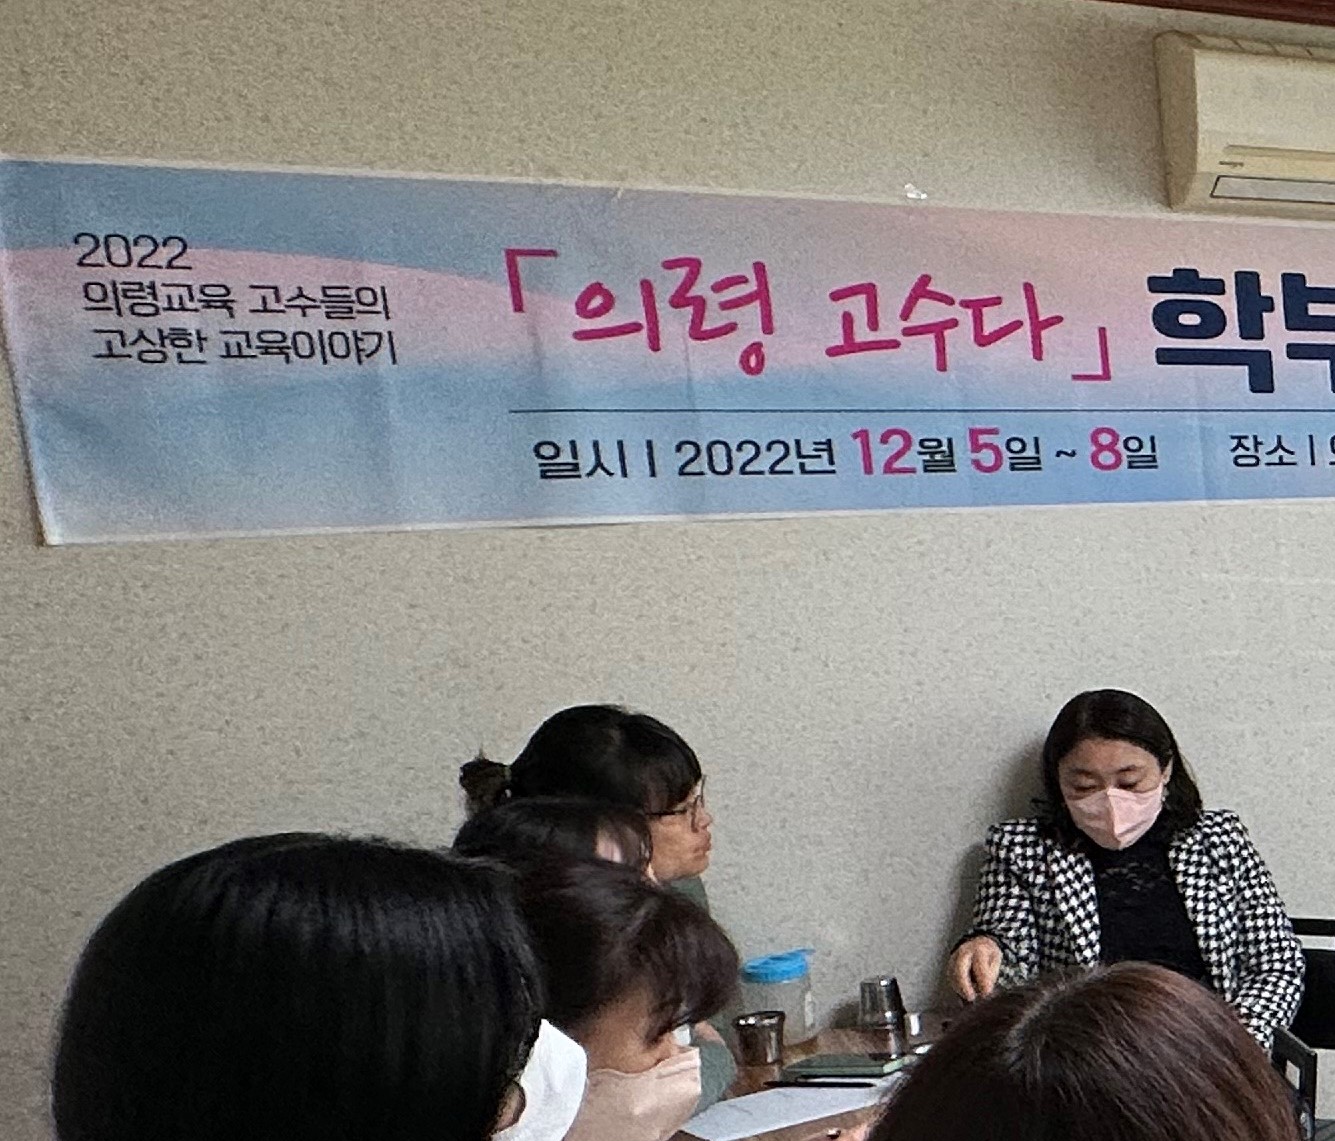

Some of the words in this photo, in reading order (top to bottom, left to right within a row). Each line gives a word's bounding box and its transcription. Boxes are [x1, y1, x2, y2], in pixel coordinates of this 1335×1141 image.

[72, 232, 193, 271] 2022
[82, 279, 236, 319] 의령교육
[248, 284, 391, 321] 고수들의
[92, 327, 208, 366] 고상한
[219, 329, 398, 366] 교육이야기
[532, 439, 628, 480] 일시
[674, 438, 837, 477] 2022년
[852, 428, 957, 475] 12월
[969, 427, 1043, 473] 5일
[1090, 427, 1159, 471] 8일
[1229, 434, 1297, 468] 장소
